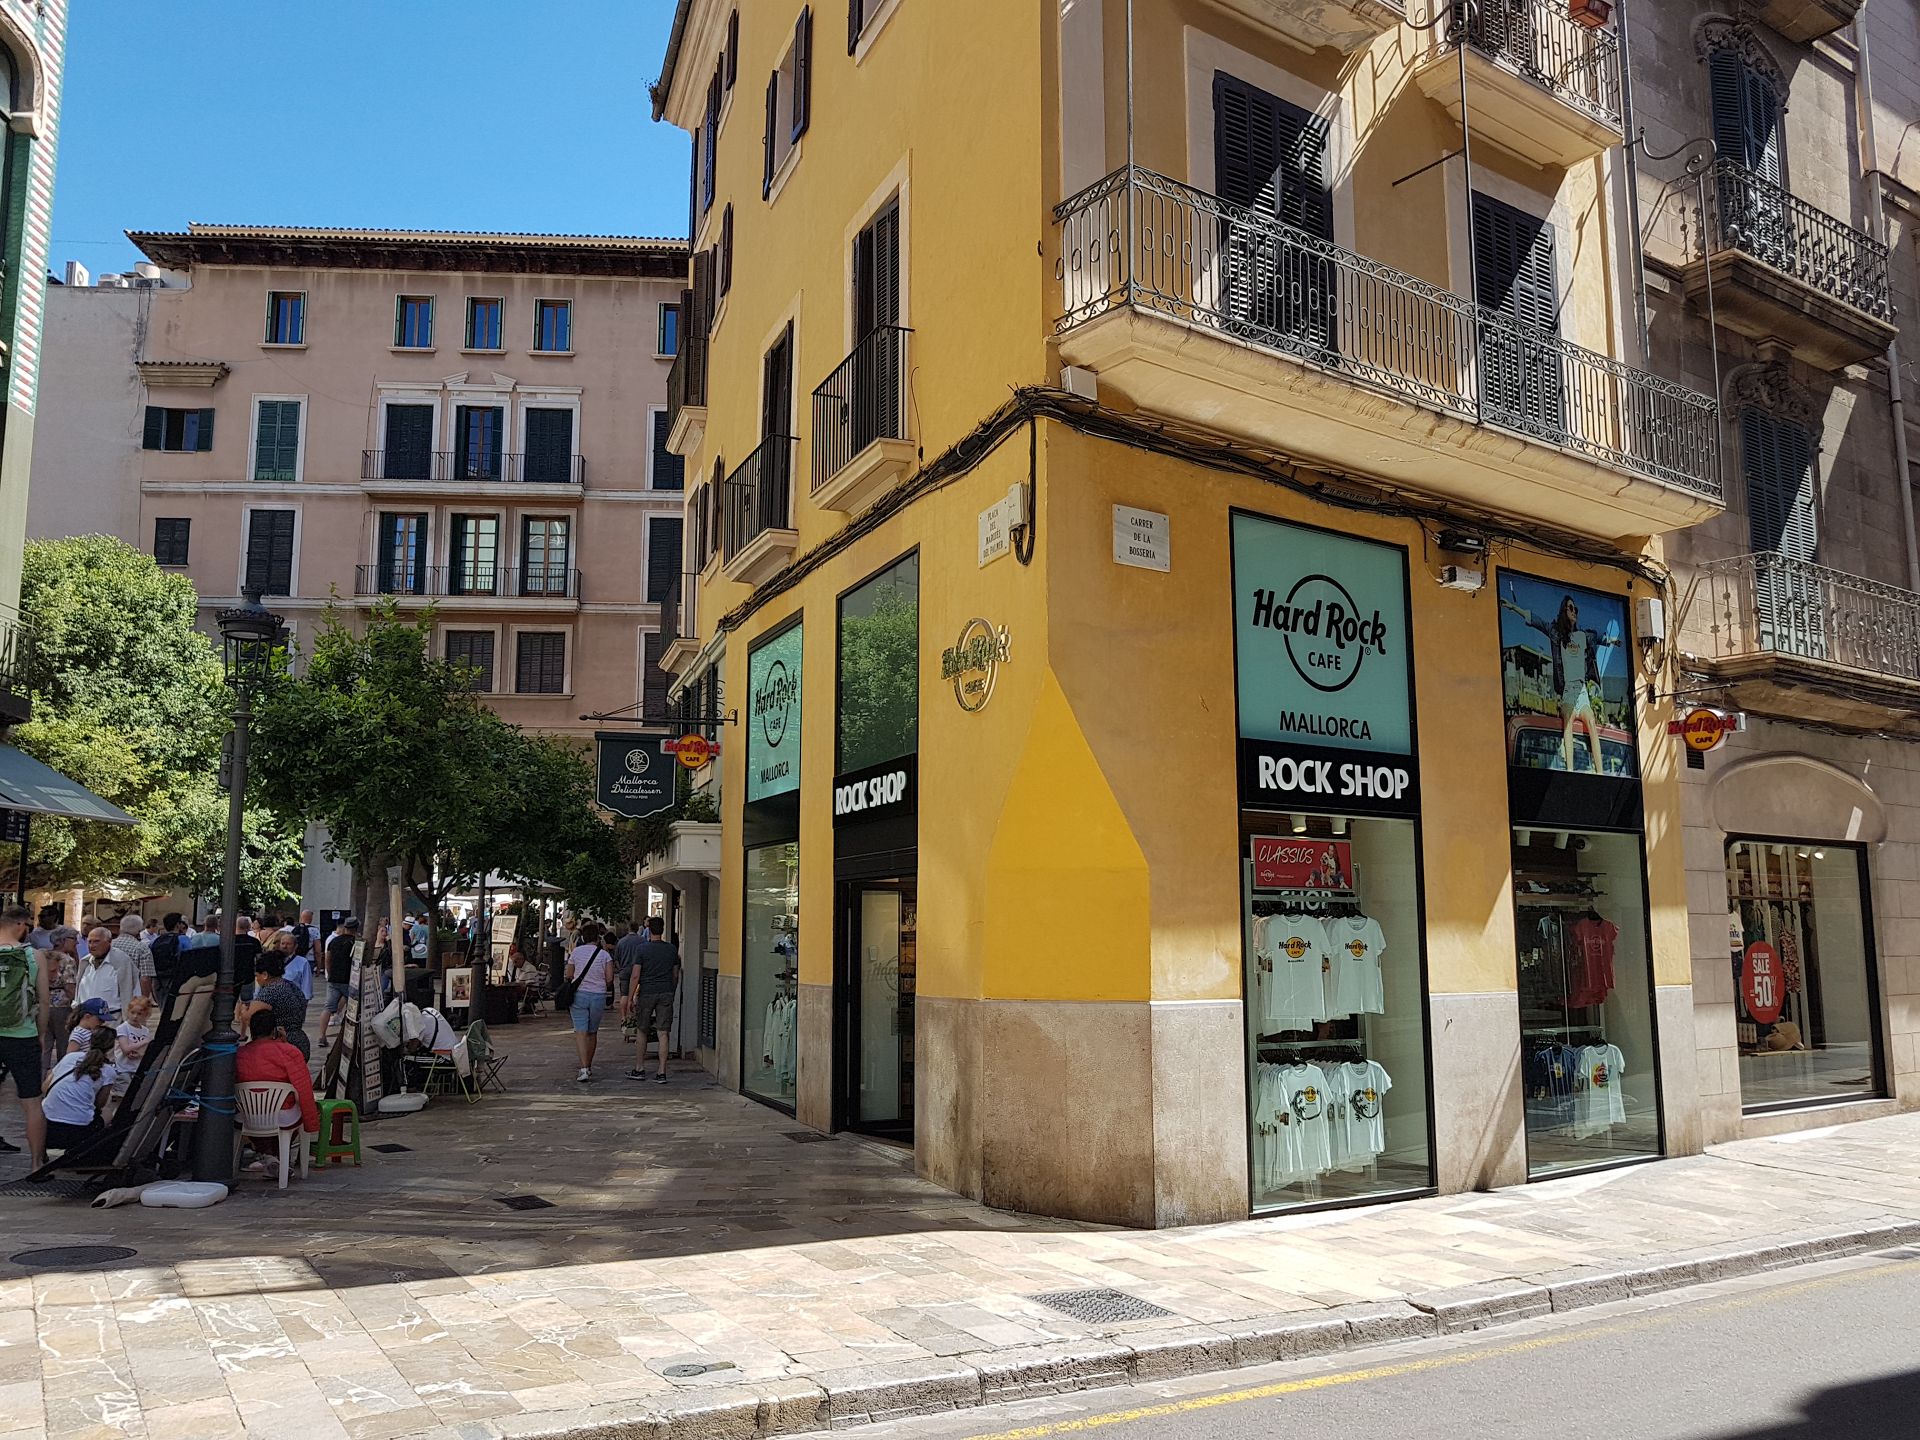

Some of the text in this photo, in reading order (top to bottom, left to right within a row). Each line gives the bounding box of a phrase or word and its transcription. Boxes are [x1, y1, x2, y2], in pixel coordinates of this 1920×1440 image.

[1130, 517, 1153, 529] CARRER
[1133, 532, 1151, 544] DE LA
[1129, 546, 1156, 560] BOSSERIA
[1252, 588, 1386, 655] Hard Rock
[1308, 651, 1342, 671] CAFE
[754, 669, 798, 717] Hard Rock
[769, 717, 782, 731] CAFE
[1279, 710, 1372, 741] MALLORCA
[1668, 715, 1737, 735] Hard Rock
[664, 740, 721, 756] Hard Rock
[616, 775, 659, 785] Mallorca
[760, 761, 790, 785] MALLORCA
[1258, 755, 1409, 799] ROCK SHOP
[610, 783, 662, 794] Delicatessen
[835, 771, 907, 816] ROCK SHOP
[1258, 845, 1314, 864] CLASSICS
[1278, 940, 1312, 950] Hard Rock
[1752, 959, 1770, 974] SALE
